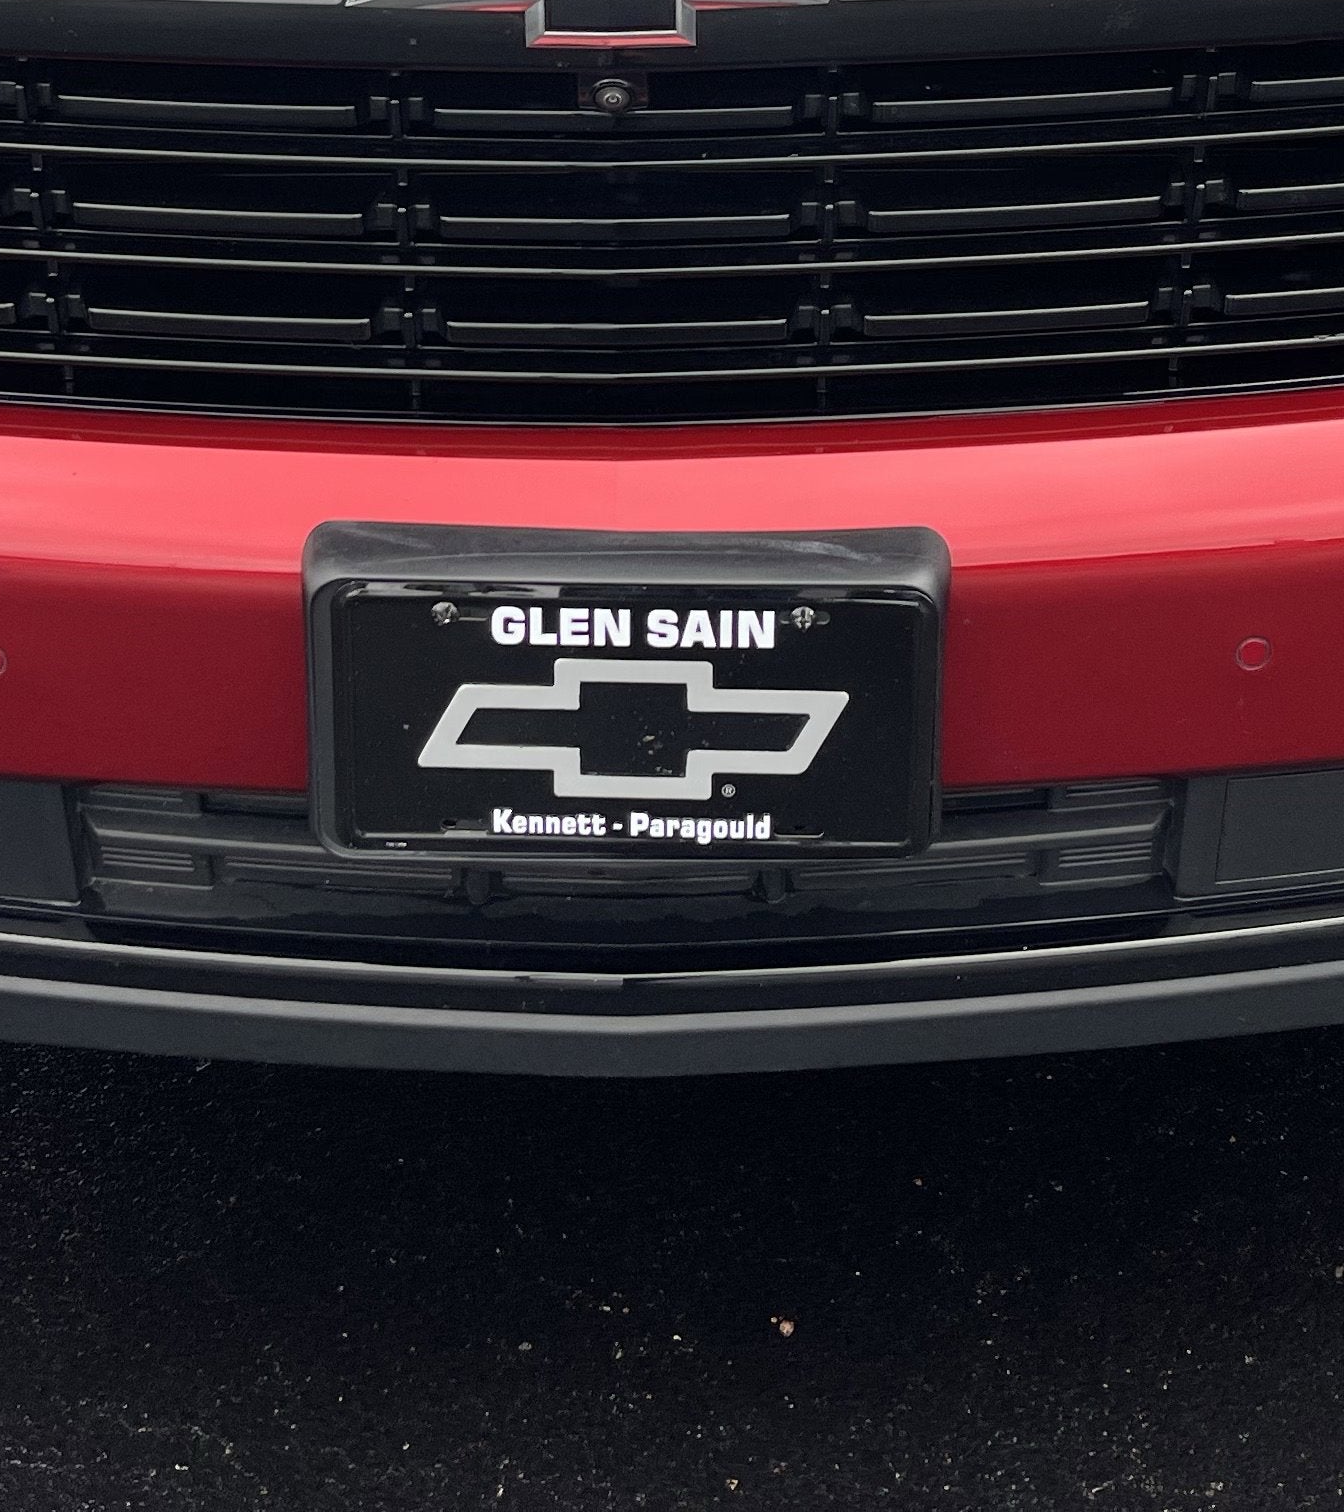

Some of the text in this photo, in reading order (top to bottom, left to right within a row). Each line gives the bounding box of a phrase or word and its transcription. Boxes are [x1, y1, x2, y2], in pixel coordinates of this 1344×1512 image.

[490, 605, 777, 650] GLEN SAIN
[492, 808, 607, 838] Kennett
[629, 810, 772, 846] Paragould
